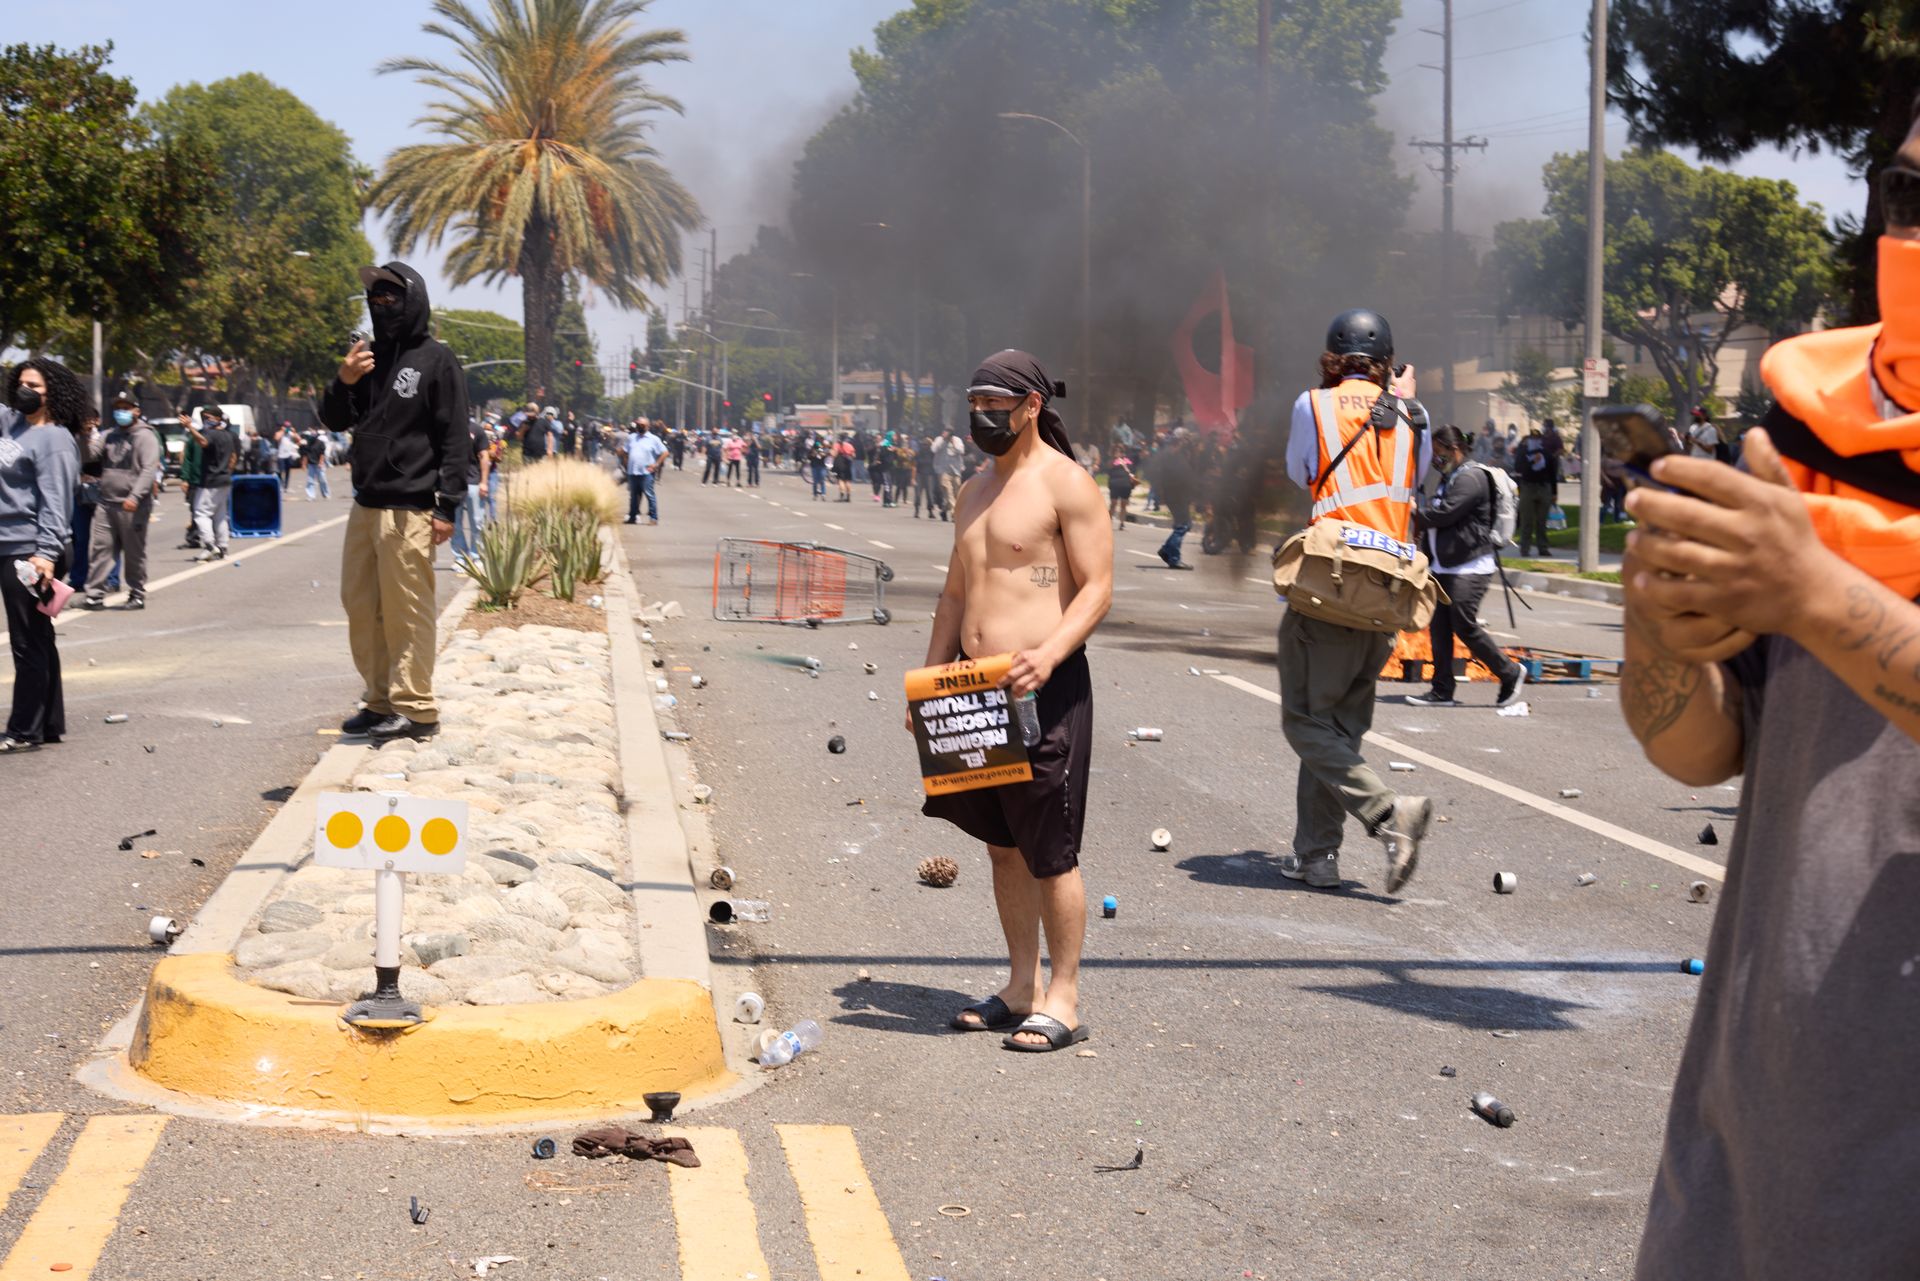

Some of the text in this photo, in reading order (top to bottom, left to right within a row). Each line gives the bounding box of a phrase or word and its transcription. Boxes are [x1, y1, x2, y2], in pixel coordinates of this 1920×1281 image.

[1338, 395, 1376, 411] PRE
[934, 671, 989, 690] TIENE
[919, 688, 1008, 718] DE TRUMP
[923, 708, 1010, 736] FASCISTA
